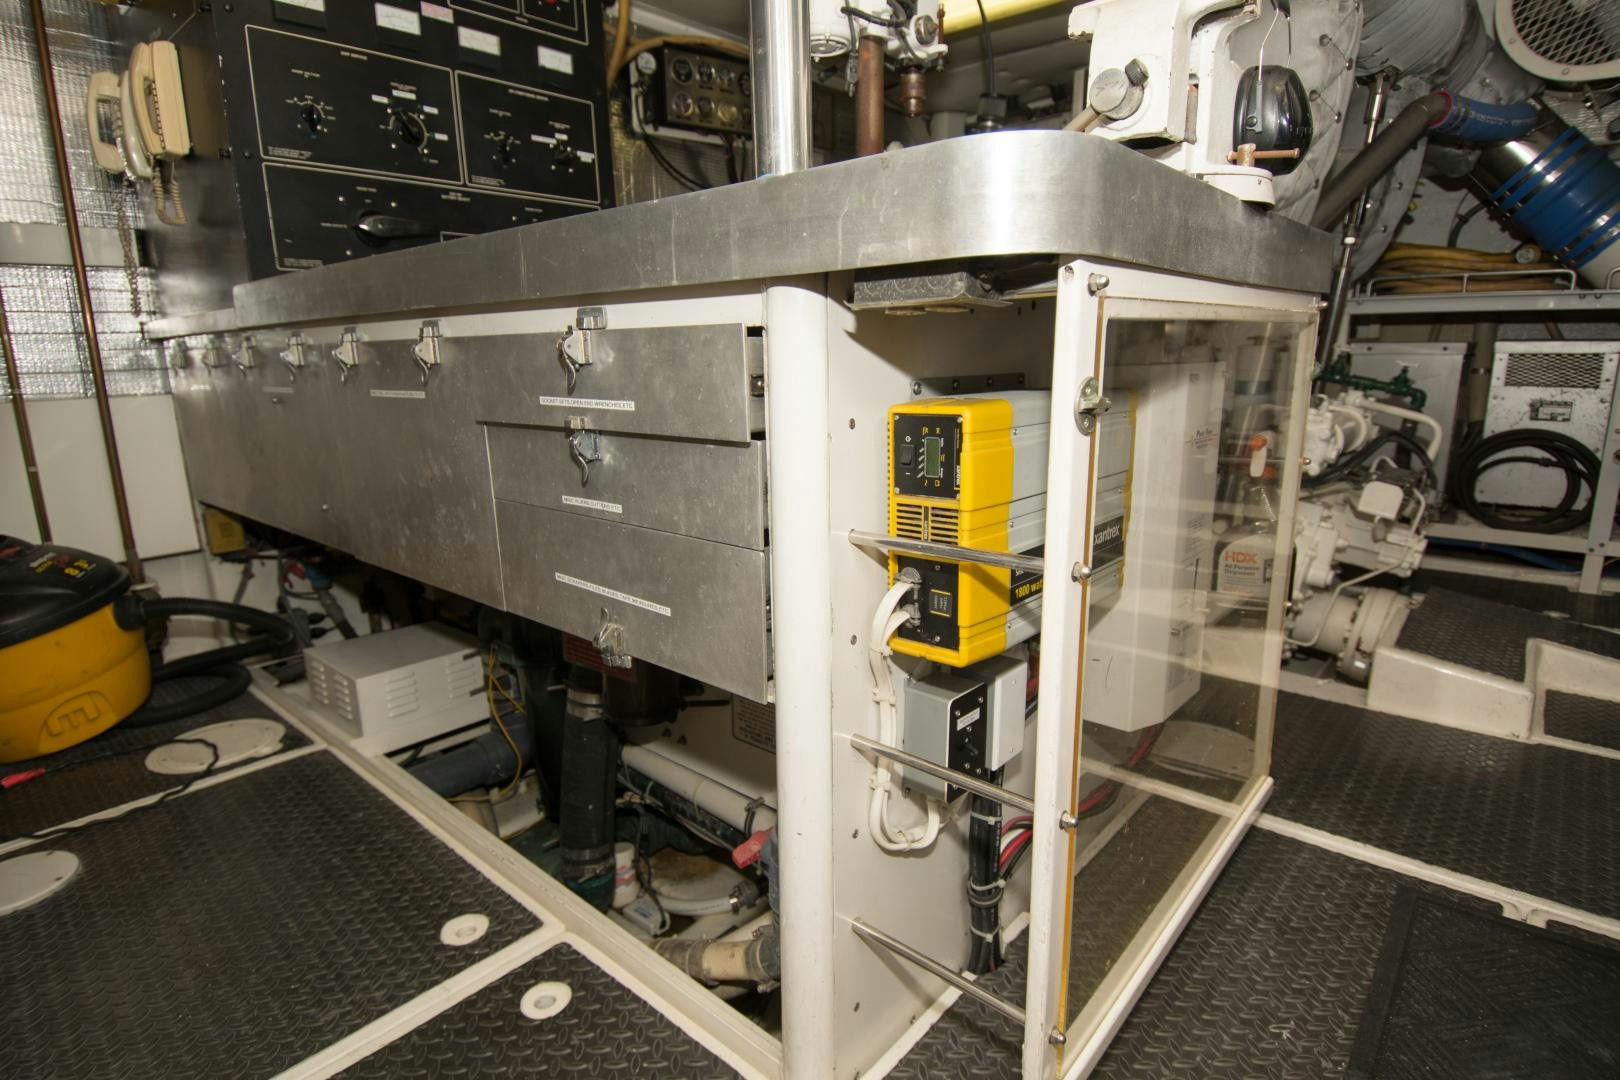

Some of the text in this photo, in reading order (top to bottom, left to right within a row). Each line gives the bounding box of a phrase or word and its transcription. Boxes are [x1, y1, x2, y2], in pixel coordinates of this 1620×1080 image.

[1094, 525, 1120, 545] xantrex
[1224, 551, 1258, 564] HDX
[1015, 577, 1043, 598] 1800 wat
